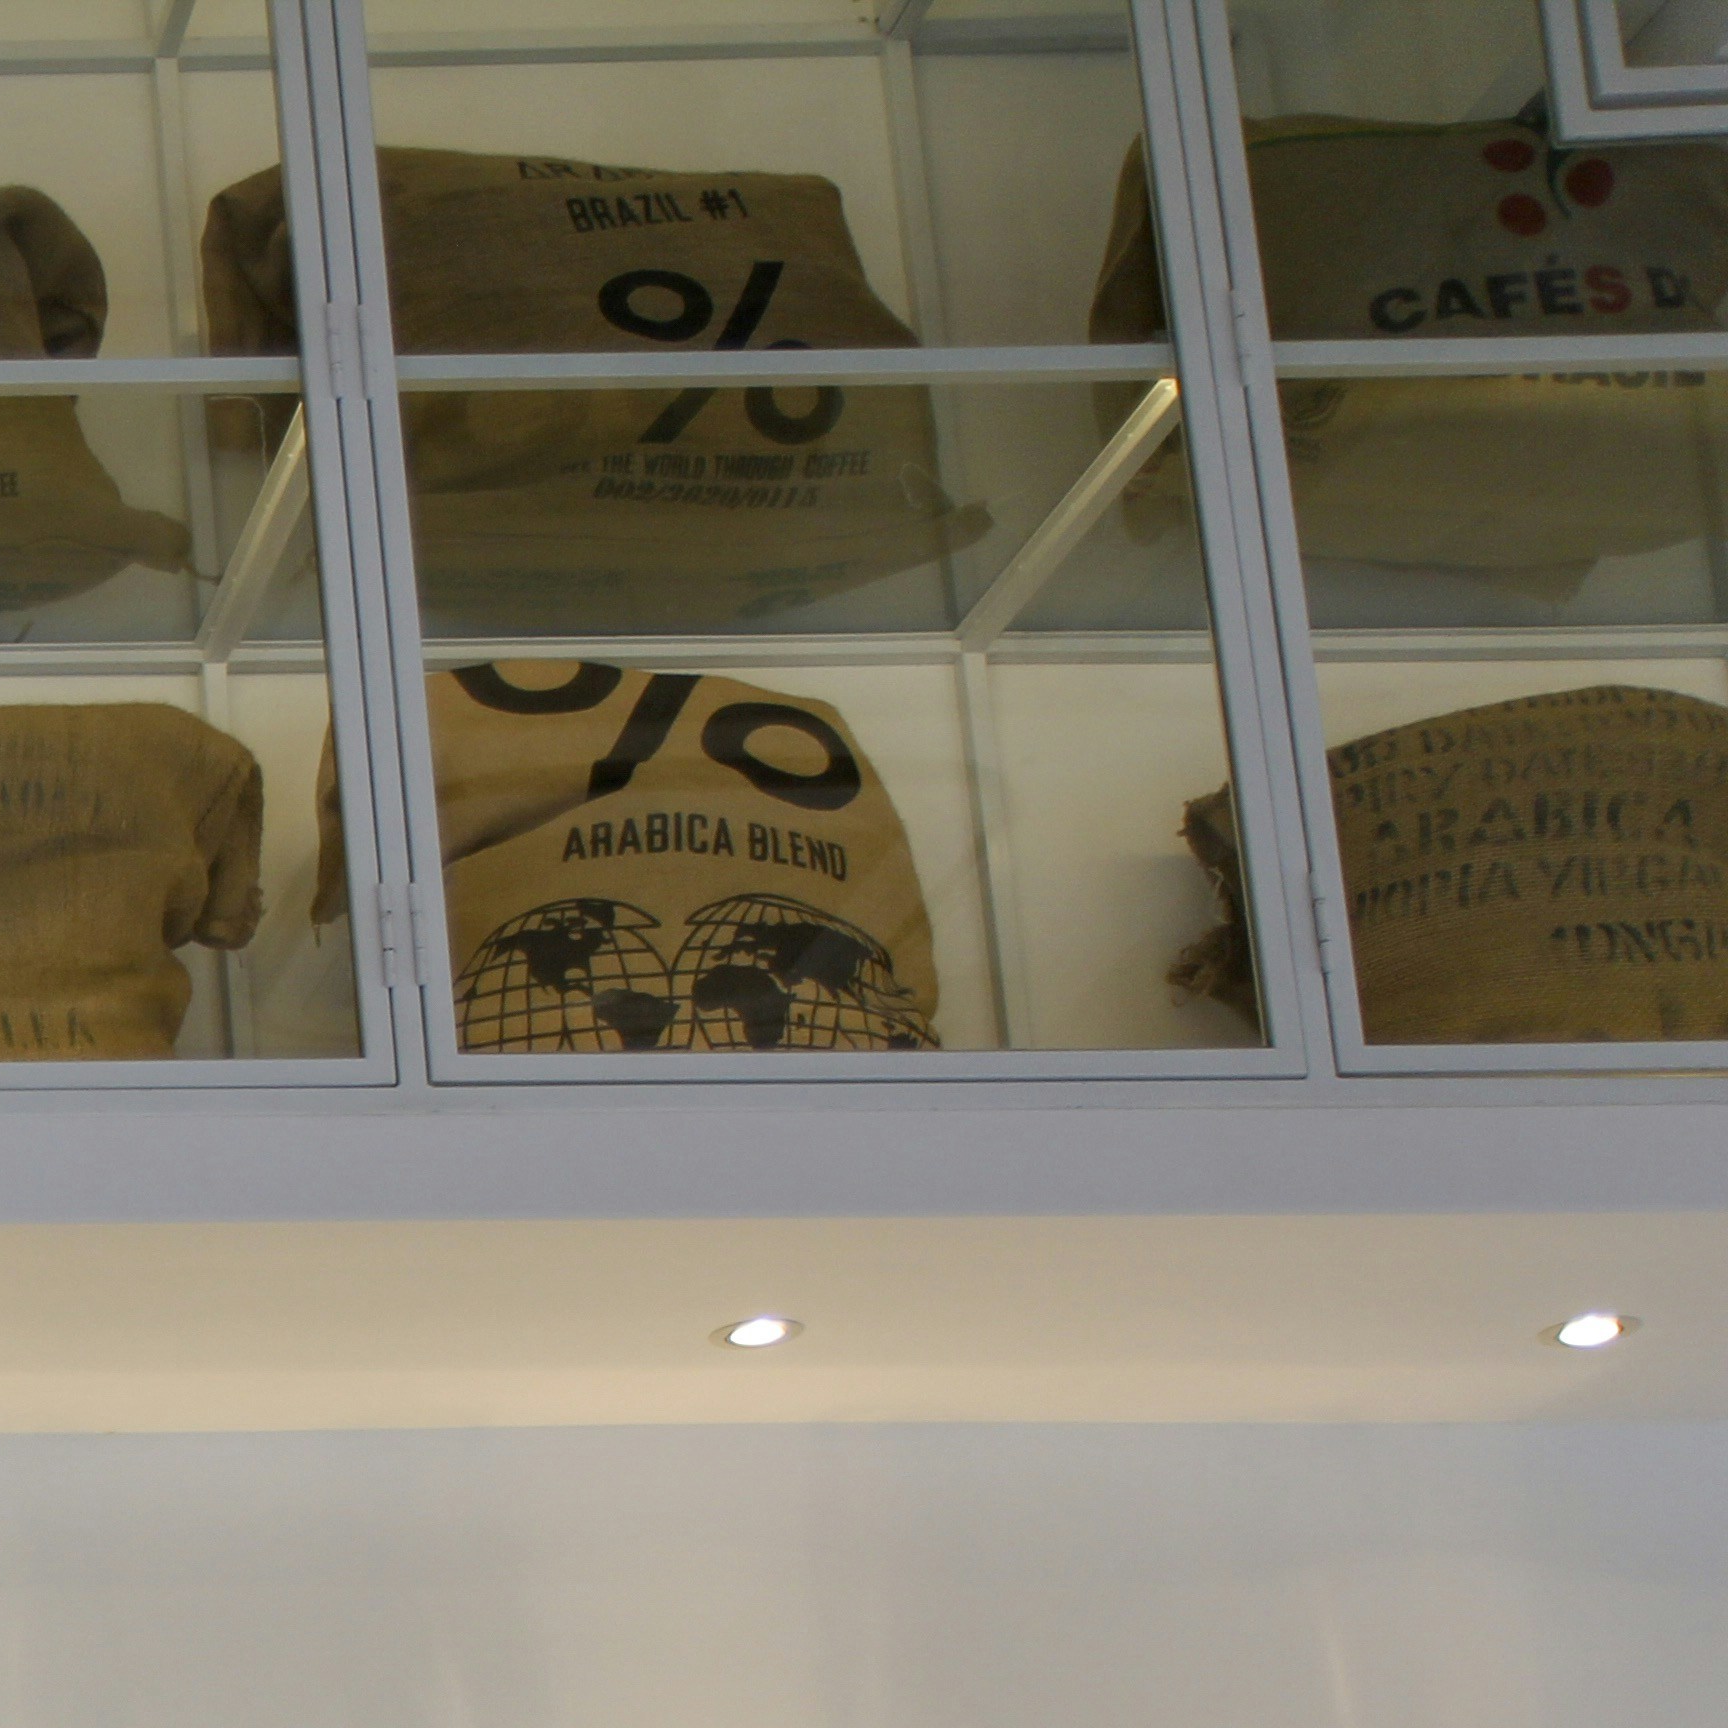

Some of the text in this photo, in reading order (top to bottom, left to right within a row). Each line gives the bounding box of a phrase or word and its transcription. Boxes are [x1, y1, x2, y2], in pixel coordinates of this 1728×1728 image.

[566, 188, 749, 233] BRAZIL #1
[1369, 254, 1634, 334] CAFÉS
[602, 452, 635, 476] THE
[643, 453, 707, 479] WORLD
[714, 454, 794, 480] THROUGH
[801, 449, 871, 479] COFFEE
[562, 812, 849, 882] ARABICA BLEND
